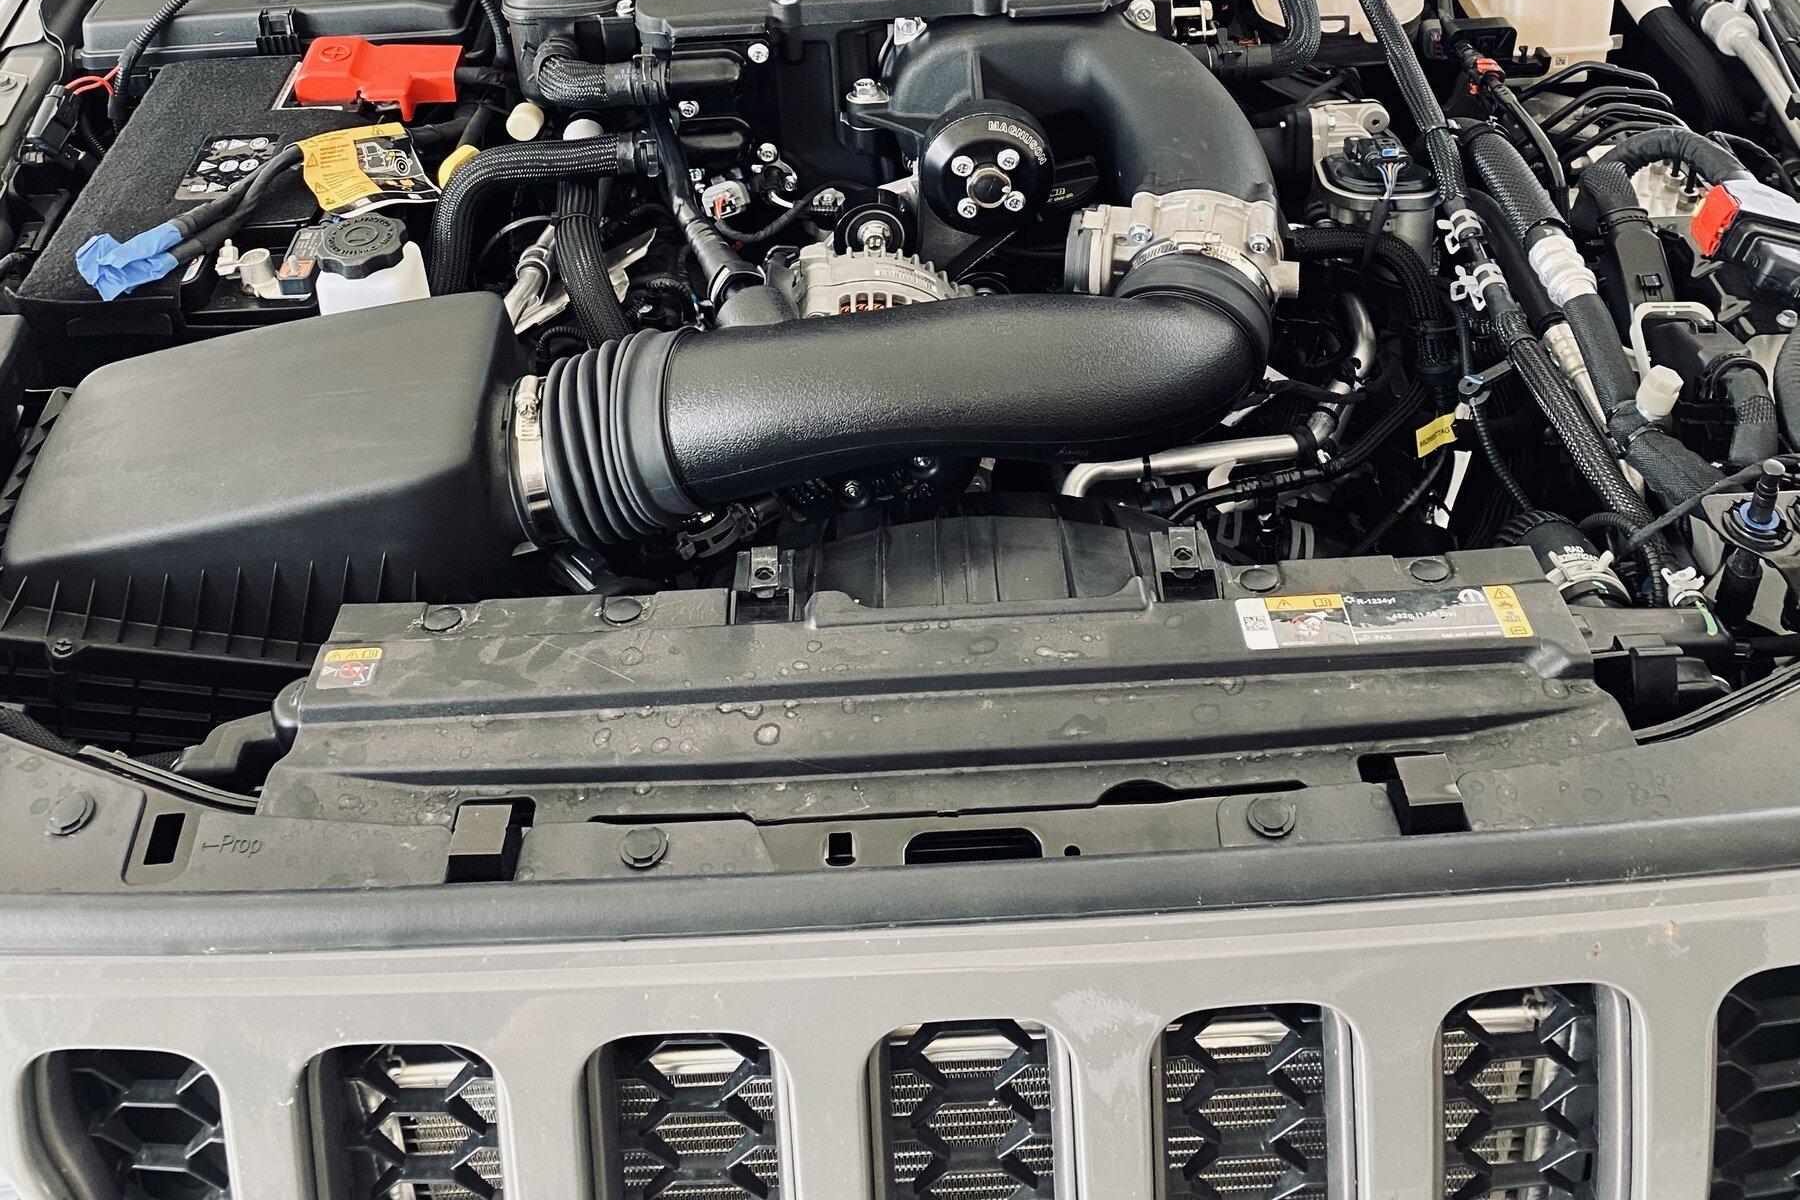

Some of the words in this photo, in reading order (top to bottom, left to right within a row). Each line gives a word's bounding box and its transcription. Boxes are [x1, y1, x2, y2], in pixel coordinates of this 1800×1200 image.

[987, 120, 1047, 165] MAGNUSON
[1563, 545, 1585, 554] RAD
[218, 833, 264, 858] Prop
